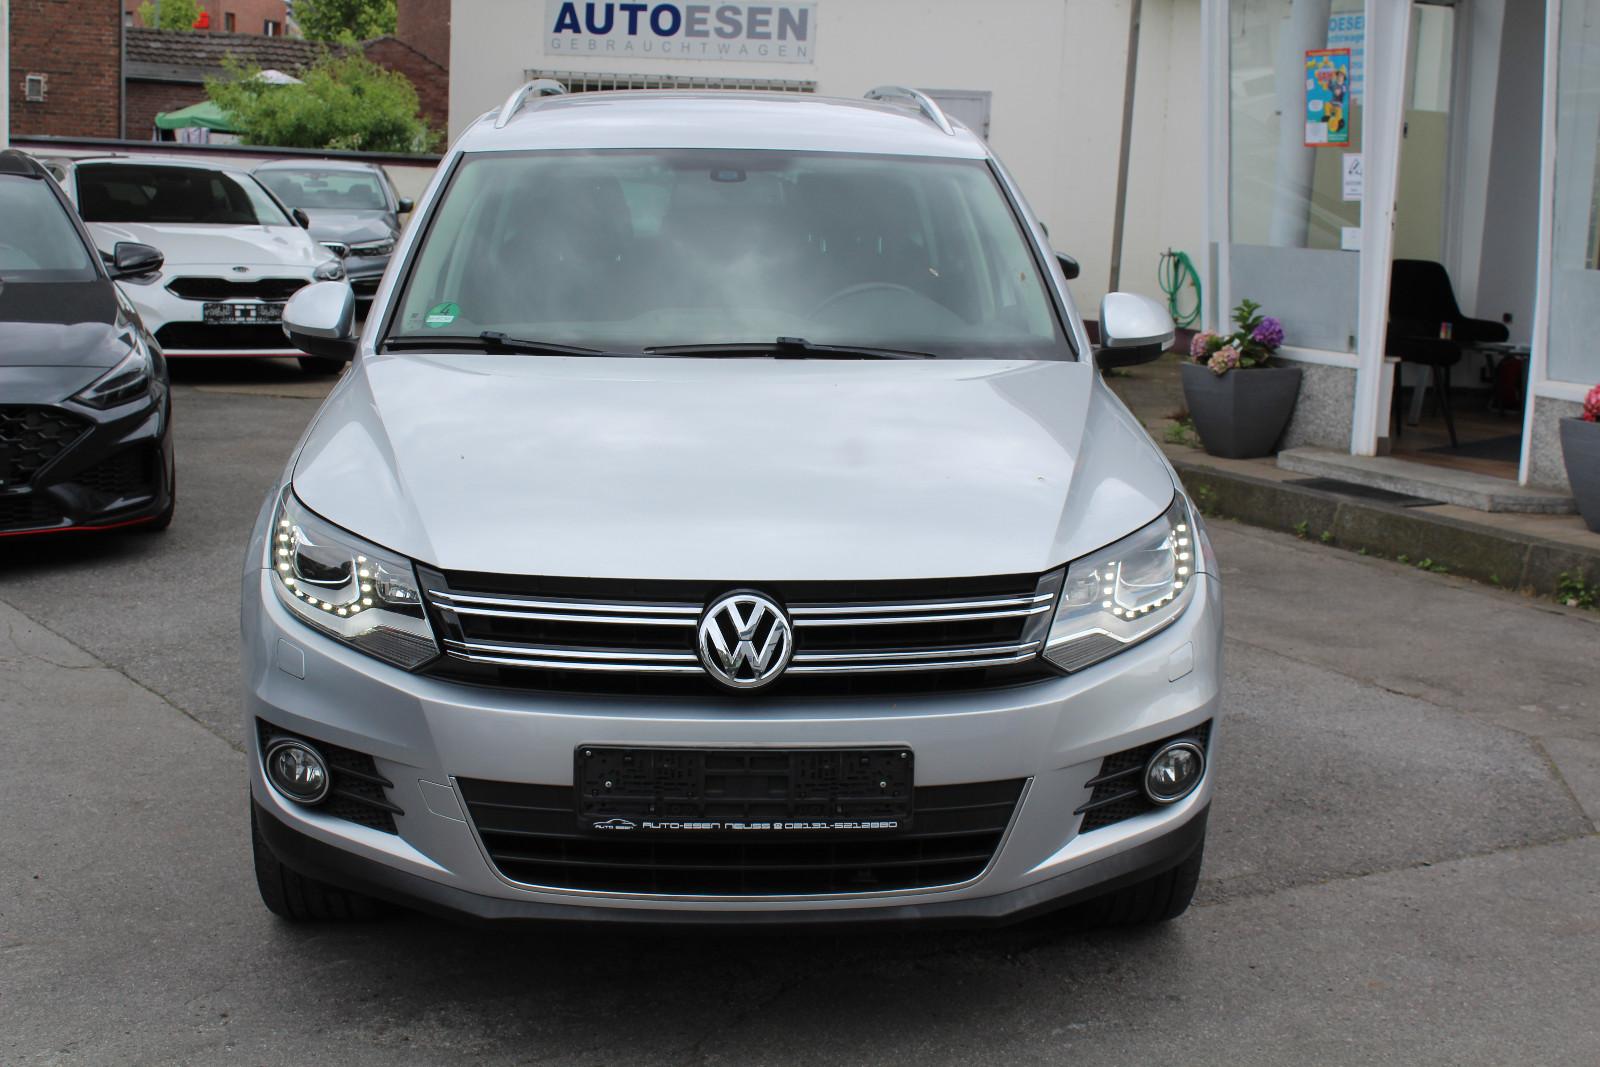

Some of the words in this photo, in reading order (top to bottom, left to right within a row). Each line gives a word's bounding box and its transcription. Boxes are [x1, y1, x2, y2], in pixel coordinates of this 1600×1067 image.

[552, 2, 810, 41] AUTOESEN
[551, 37, 808, 57] GEBRAUCHTWAGEN
[440, 303, 452, 316] 4
